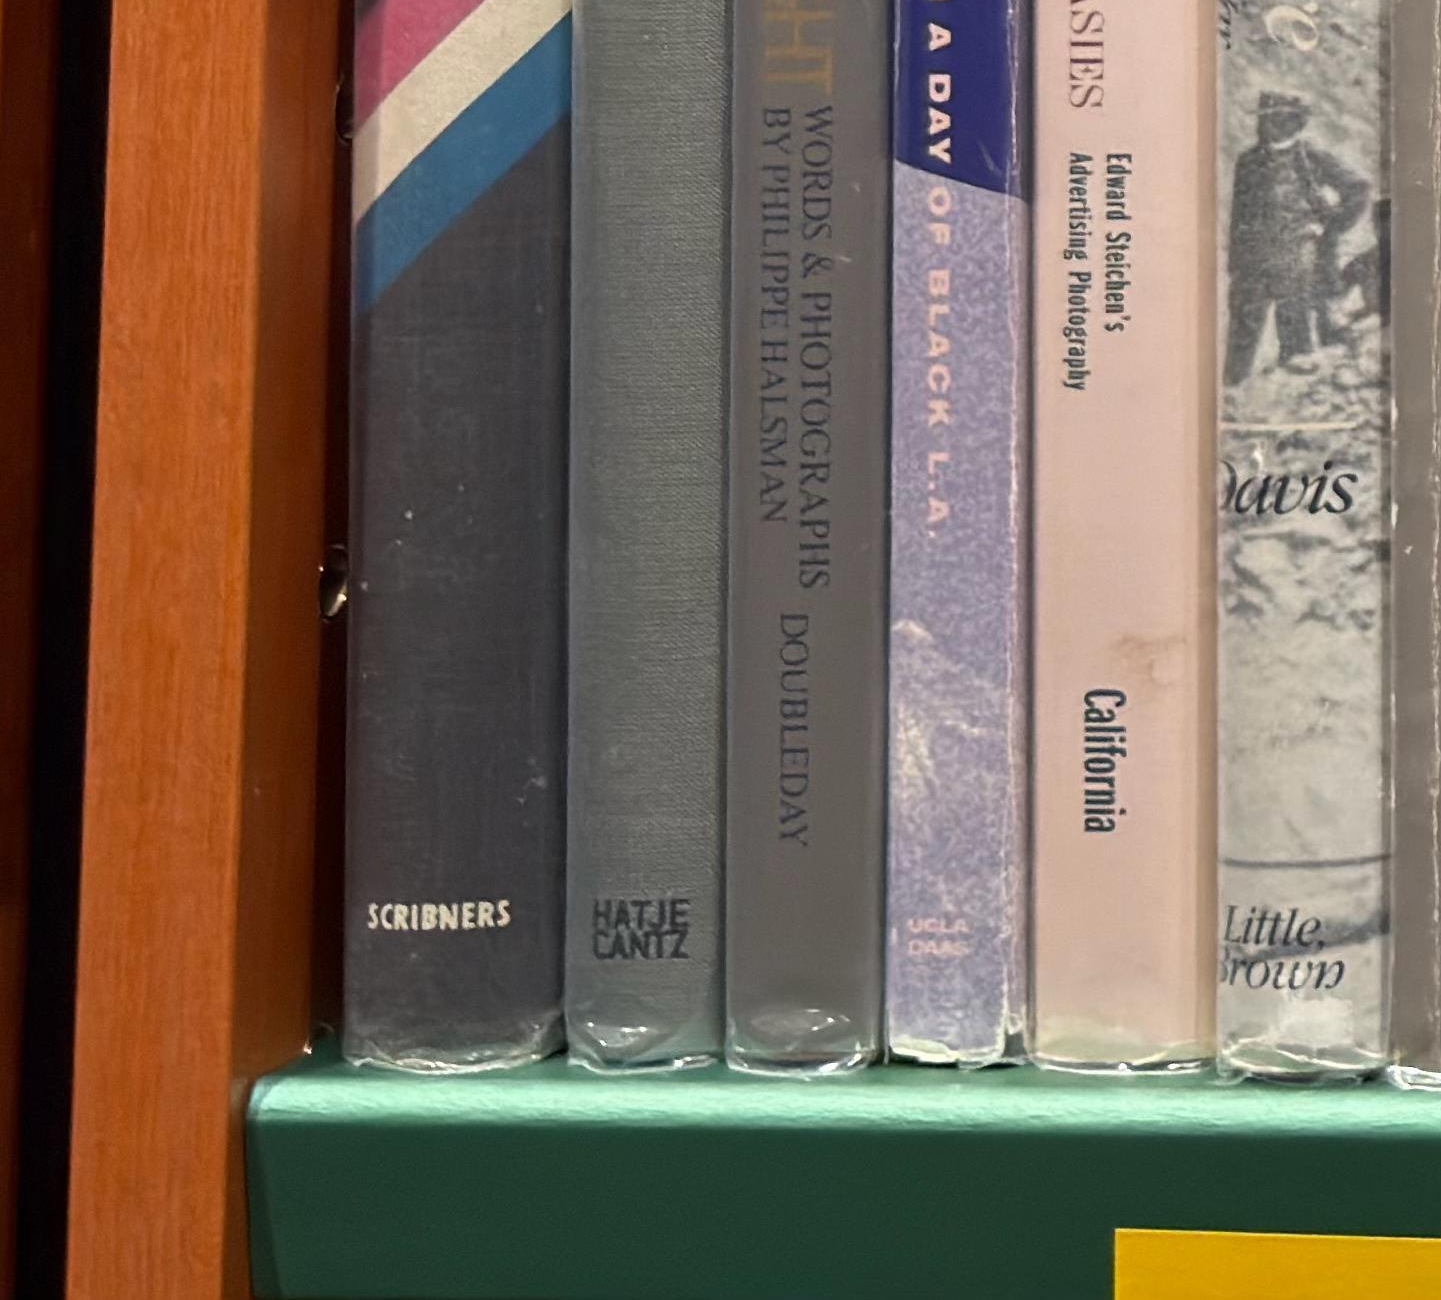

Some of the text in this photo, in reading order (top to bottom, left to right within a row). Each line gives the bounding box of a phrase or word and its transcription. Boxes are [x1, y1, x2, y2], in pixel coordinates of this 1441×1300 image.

[1062, 152, 1091, 390] Advertising Photography
[1104, 152, 1131, 332] Edward Steichen's
[778, 612, 810, 847] DOUBLEDAY
[1082, 688, 1126, 833] California
[367, 900, 511, 932] SCRIBNERS
[592, 899, 691, 928] HATJE
[592, 929, 689, 959] CANTZ
[1224, 904, 1326, 950] Little,
